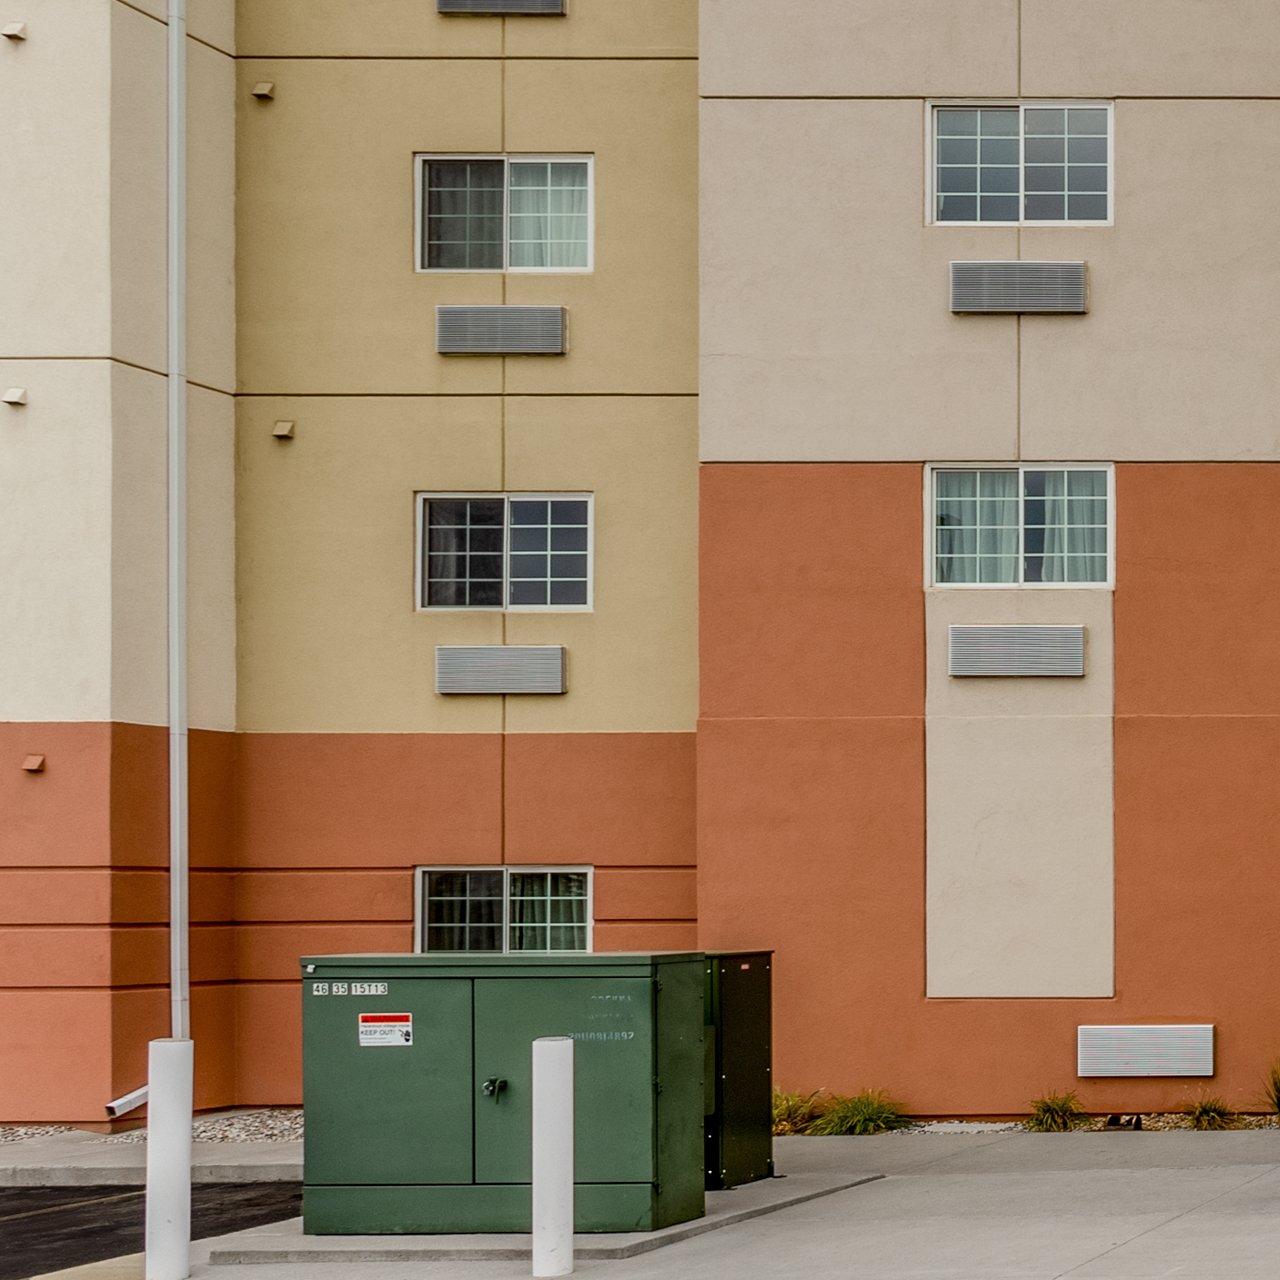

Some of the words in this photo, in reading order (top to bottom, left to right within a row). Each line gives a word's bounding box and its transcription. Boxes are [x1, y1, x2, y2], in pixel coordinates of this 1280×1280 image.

[313, 983, 328, 994] 46
[333, 983, 347, 994] 35
[352, 983, 387, 994] 15T13
